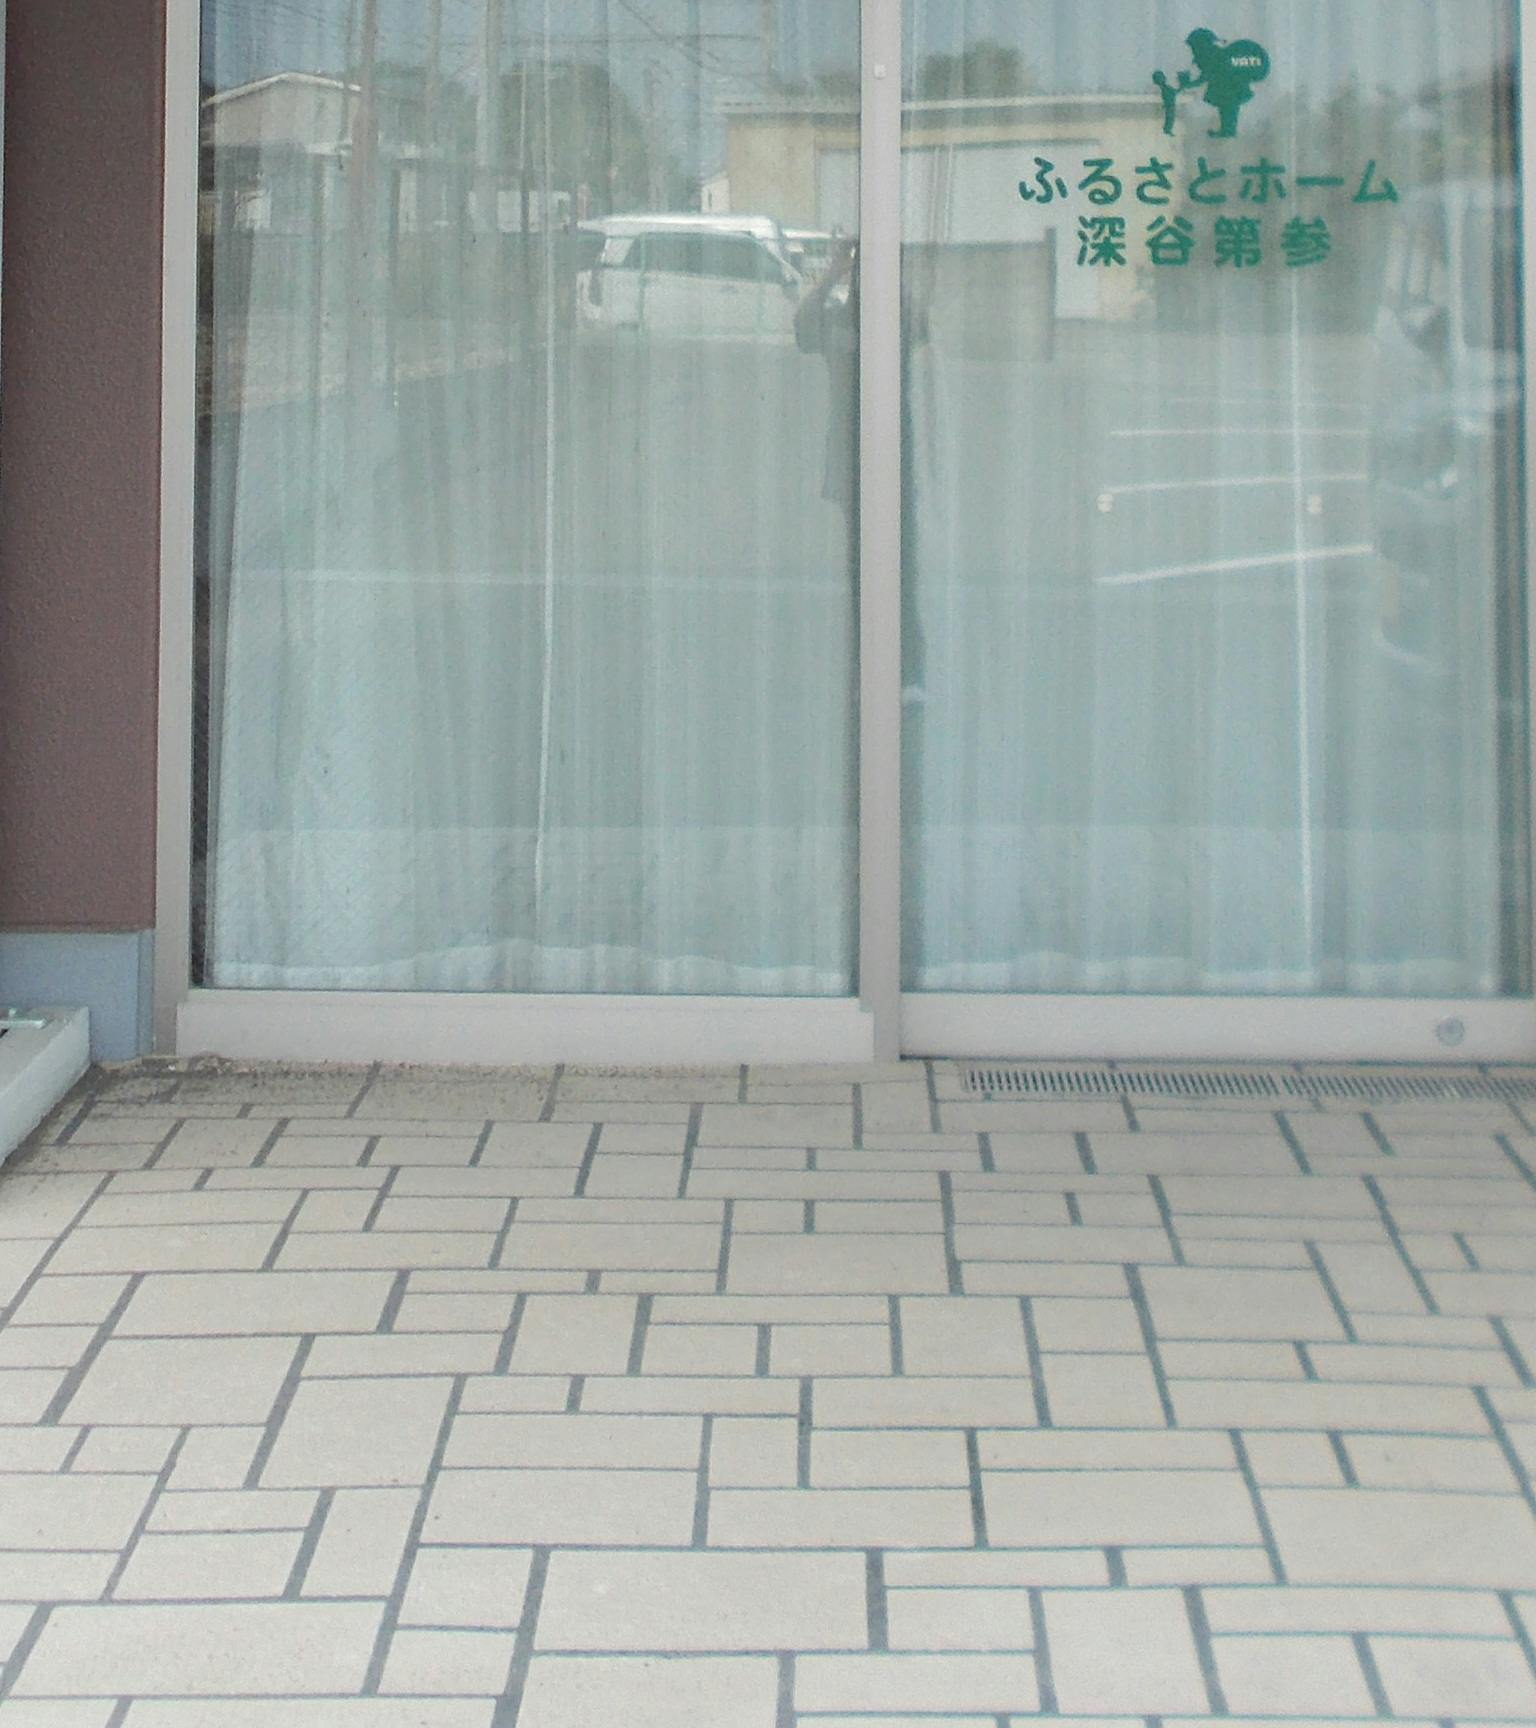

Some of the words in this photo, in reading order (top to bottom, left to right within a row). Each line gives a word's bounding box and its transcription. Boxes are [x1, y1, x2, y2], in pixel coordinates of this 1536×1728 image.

[1018, 156, 1400, 204] ふるさとホーム
[1075, 217, 1332, 268] 深谷第参
